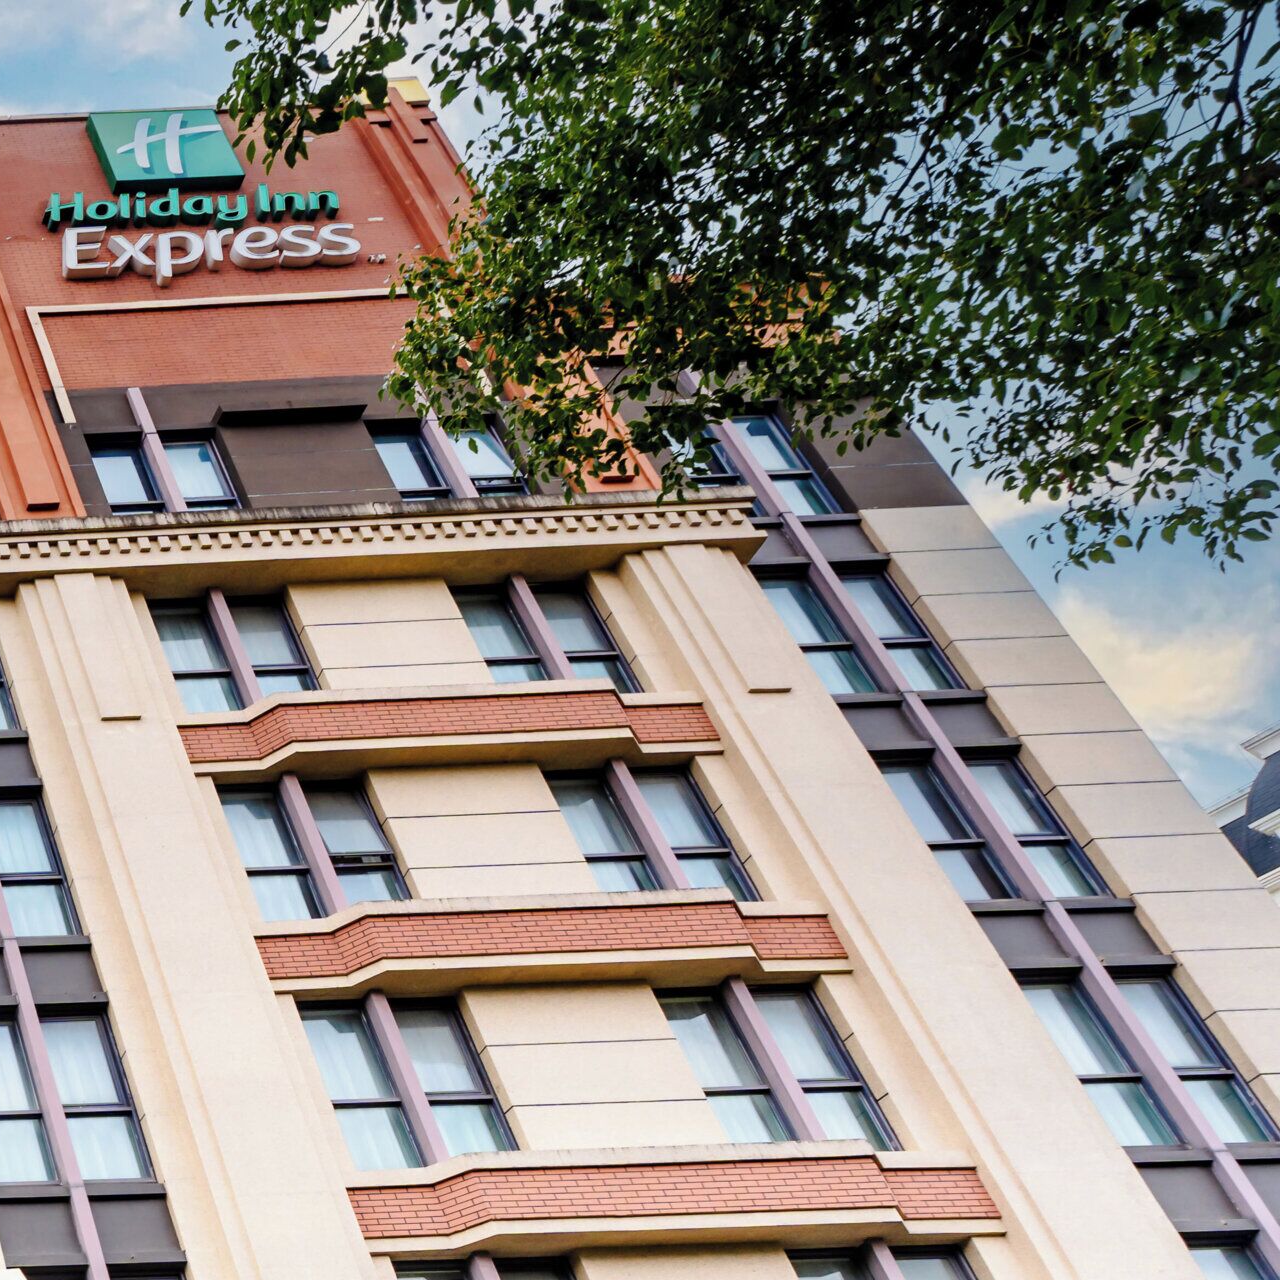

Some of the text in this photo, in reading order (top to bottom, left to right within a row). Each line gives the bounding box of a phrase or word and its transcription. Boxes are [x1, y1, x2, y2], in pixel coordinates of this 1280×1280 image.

[43, 183, 340, 231] Holiday Inn
[62, 223, 361, 287] Express
